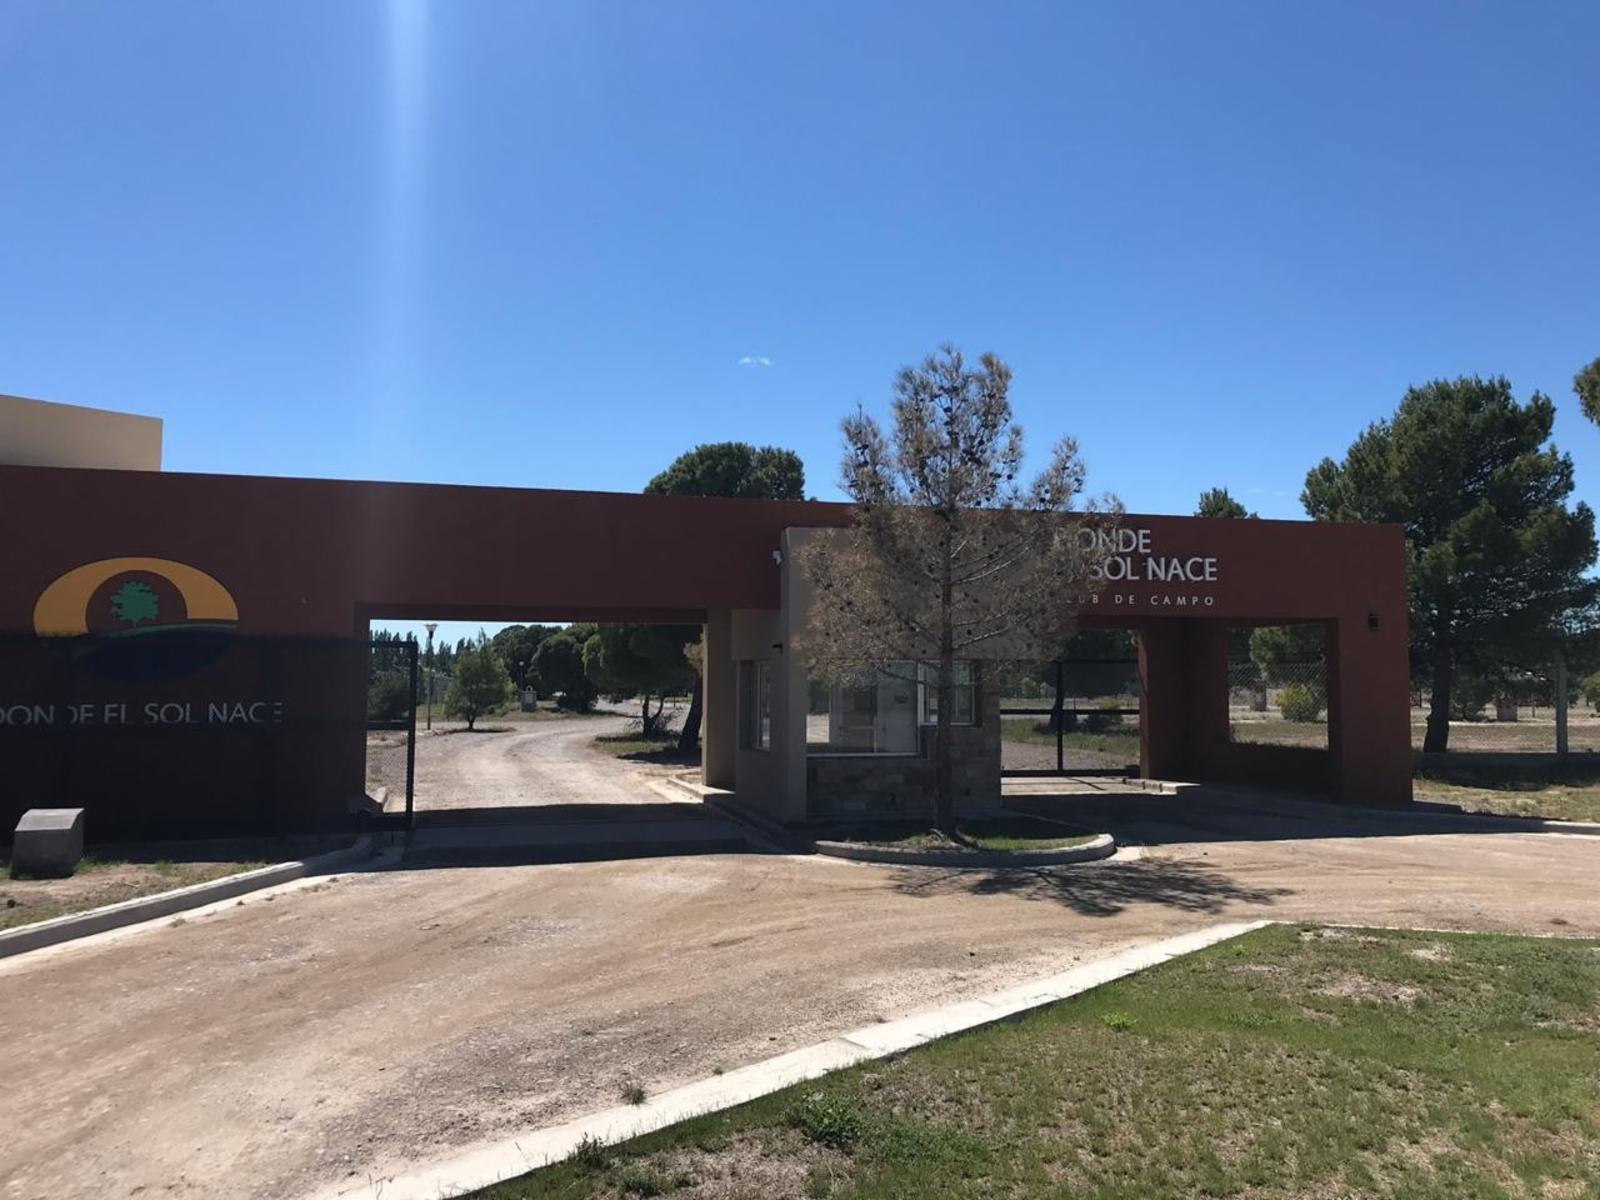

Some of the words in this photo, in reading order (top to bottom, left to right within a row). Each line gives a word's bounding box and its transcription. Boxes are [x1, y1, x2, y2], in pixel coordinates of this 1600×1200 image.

[1090, 556, 1140, 581] SOL
[1148, 557, 1218, 581] NACE
[1115, 594, 1136, 604] DE
[1151, 595, 1214, 606] CAMPO
[144, 703, 200, 723] SOL
[208, 702, 282, 723] NACE
